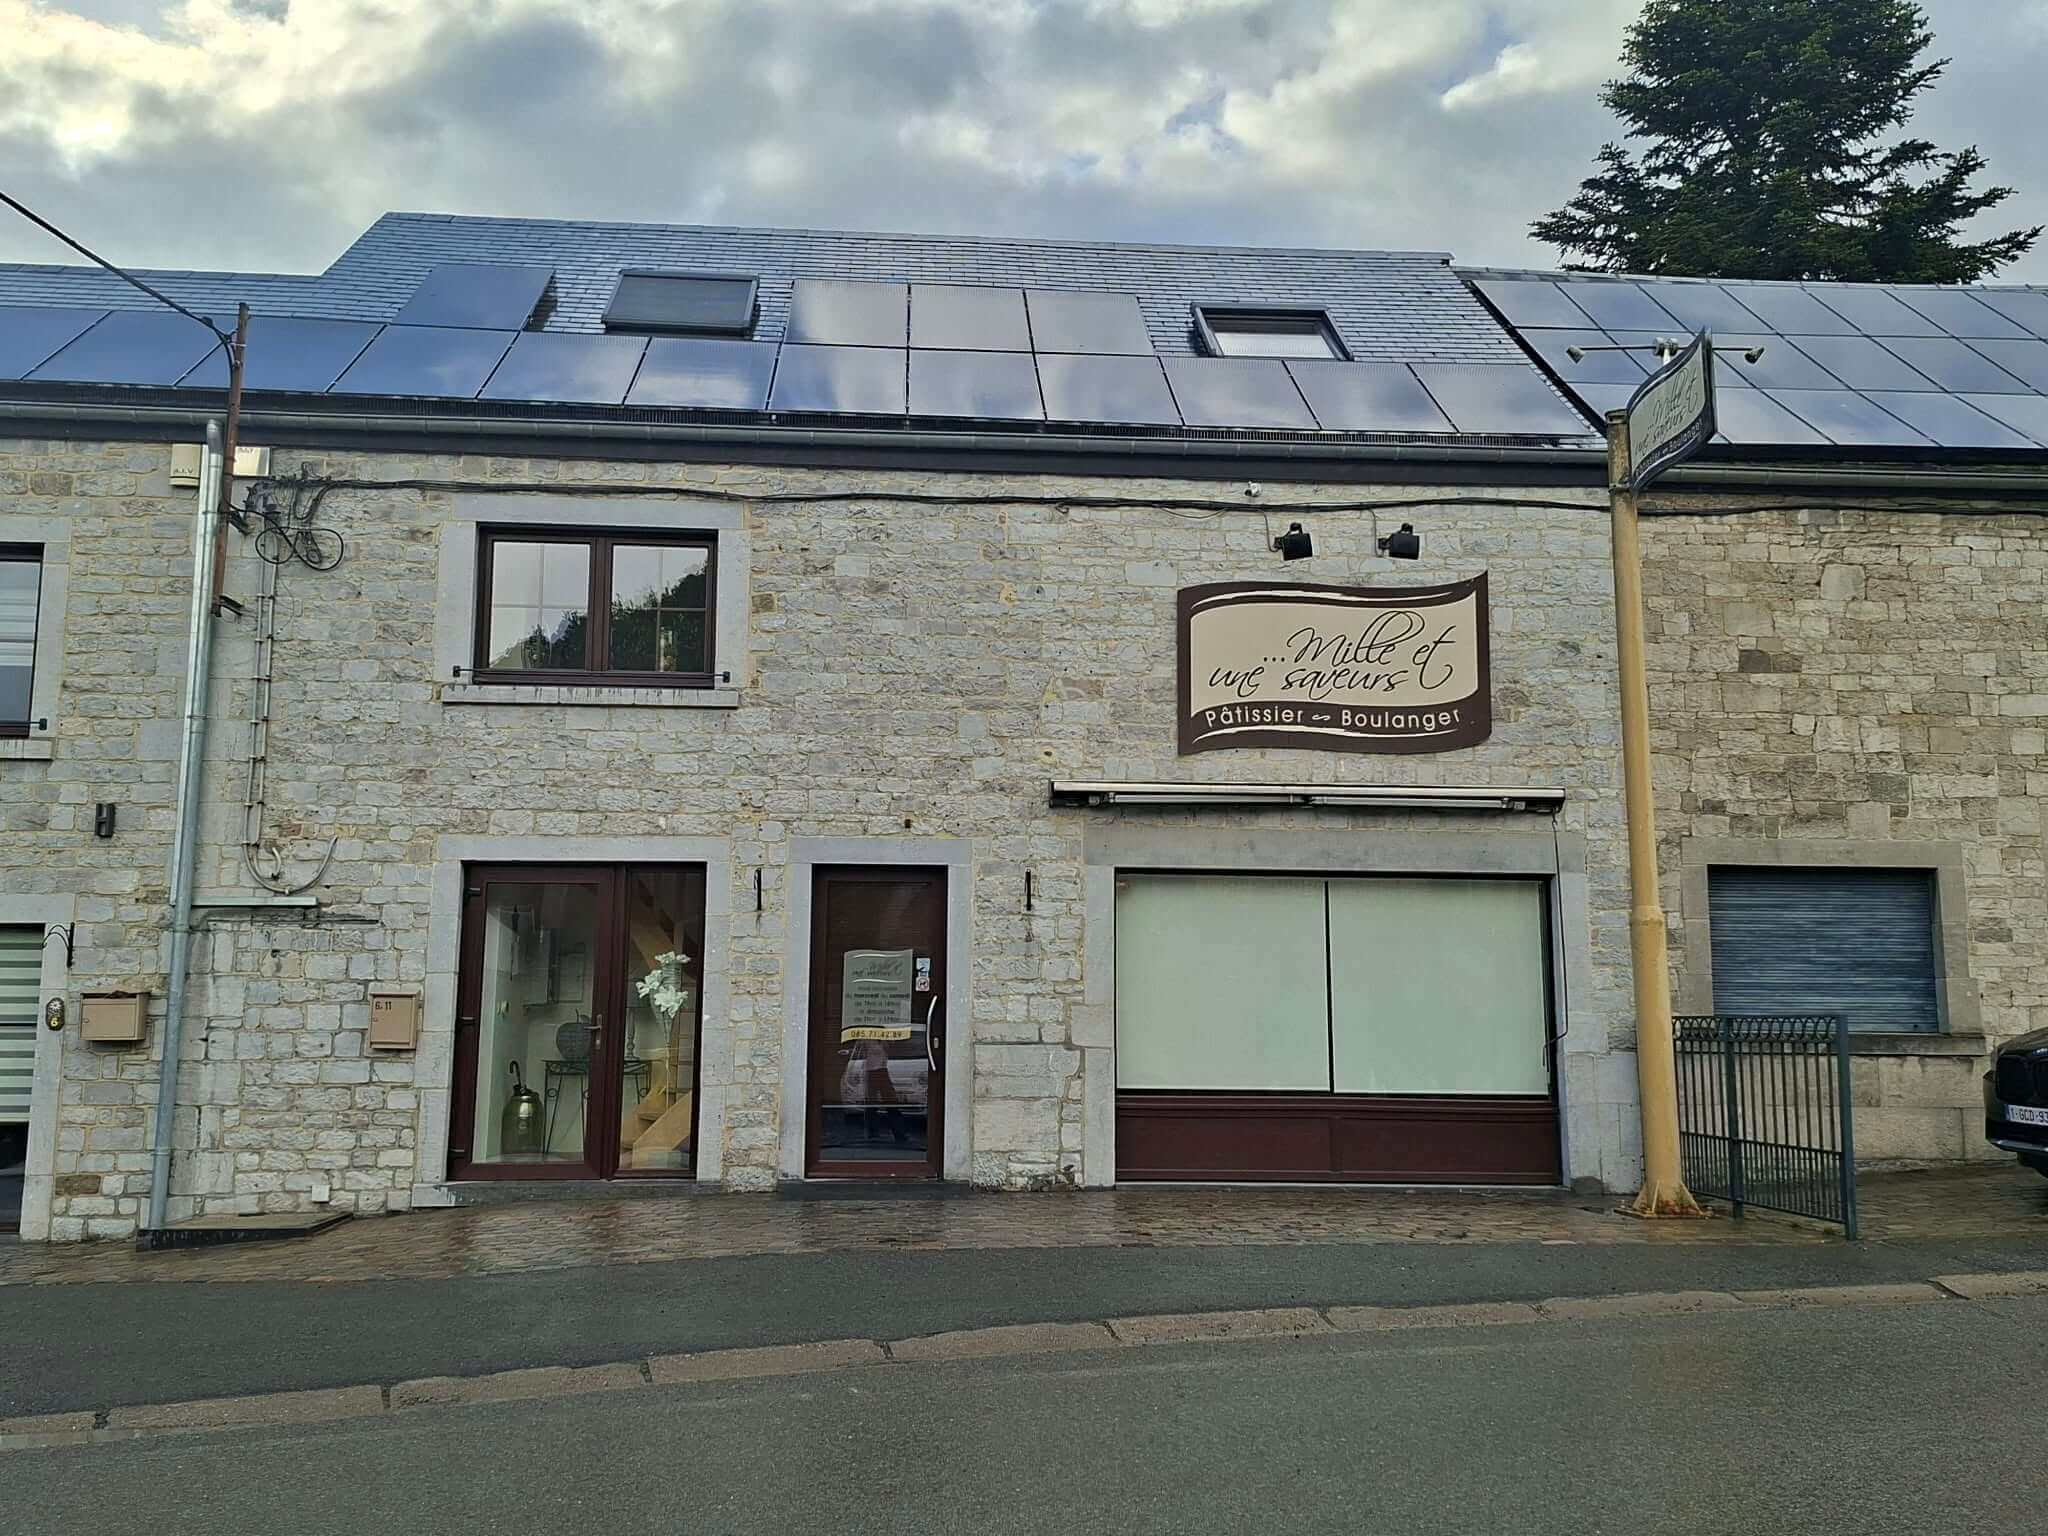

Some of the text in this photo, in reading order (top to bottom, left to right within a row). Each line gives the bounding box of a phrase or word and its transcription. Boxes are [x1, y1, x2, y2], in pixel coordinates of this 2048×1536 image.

[1412, 625, 1457, 690] et
[1208, 665, 1409, 700] une saveurs
[1205, 705, 1461, 731] Pâtissier Boulanger
